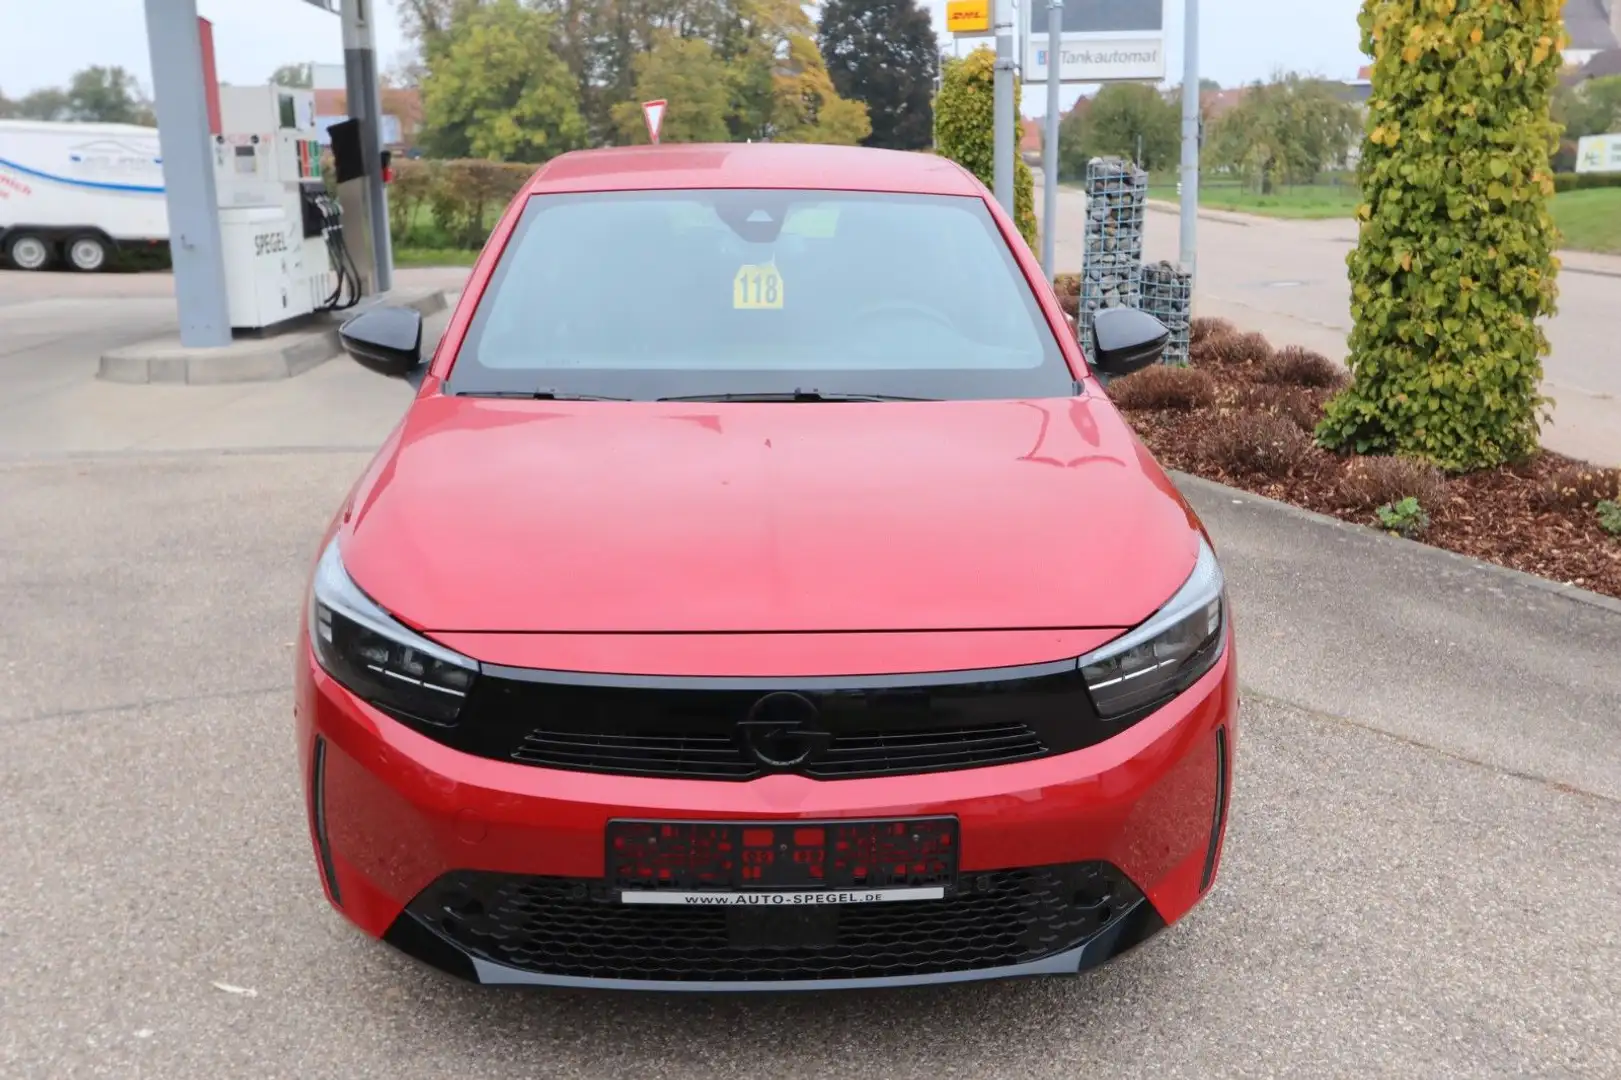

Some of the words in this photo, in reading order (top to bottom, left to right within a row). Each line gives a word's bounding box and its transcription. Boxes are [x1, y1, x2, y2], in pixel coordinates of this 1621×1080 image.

[1060, 49, 1157, 65] Tankautomat
[254, 232, 288, 256] SPEGEL
[739, 273, 778, 304] 118
[685, 892, 883, 905] www.AUTO-SPEGEL.DE
